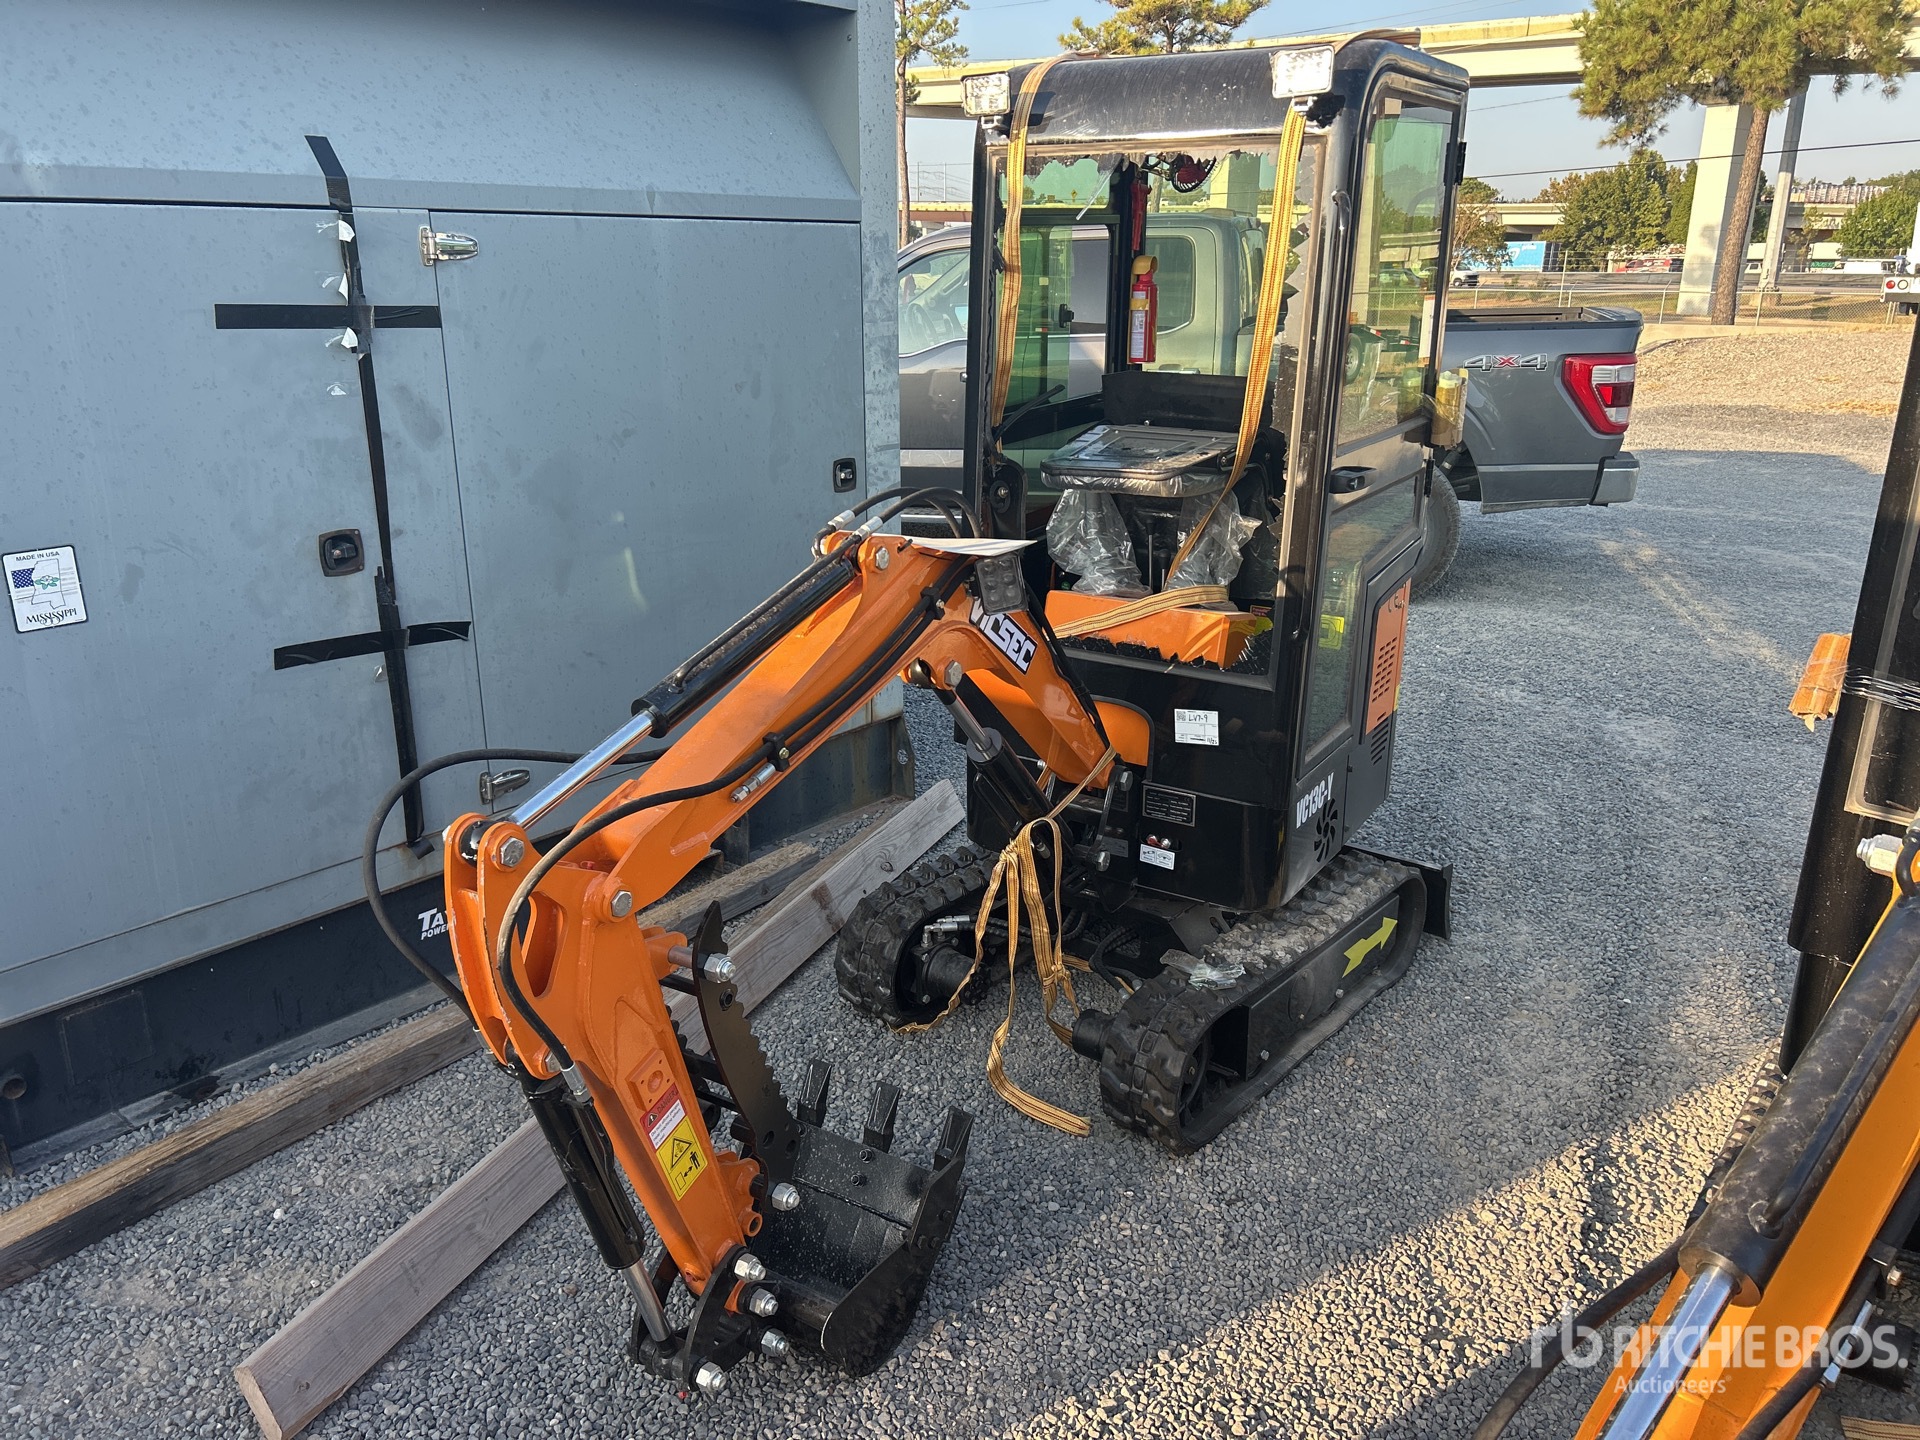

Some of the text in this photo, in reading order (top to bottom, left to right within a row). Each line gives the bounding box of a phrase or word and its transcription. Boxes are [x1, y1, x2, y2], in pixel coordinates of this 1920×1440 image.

[16, 554, 36, 562] MADE
[26, 608, 77, 626] MISSISSIPPI
[418, 907, 448, 931] TA
